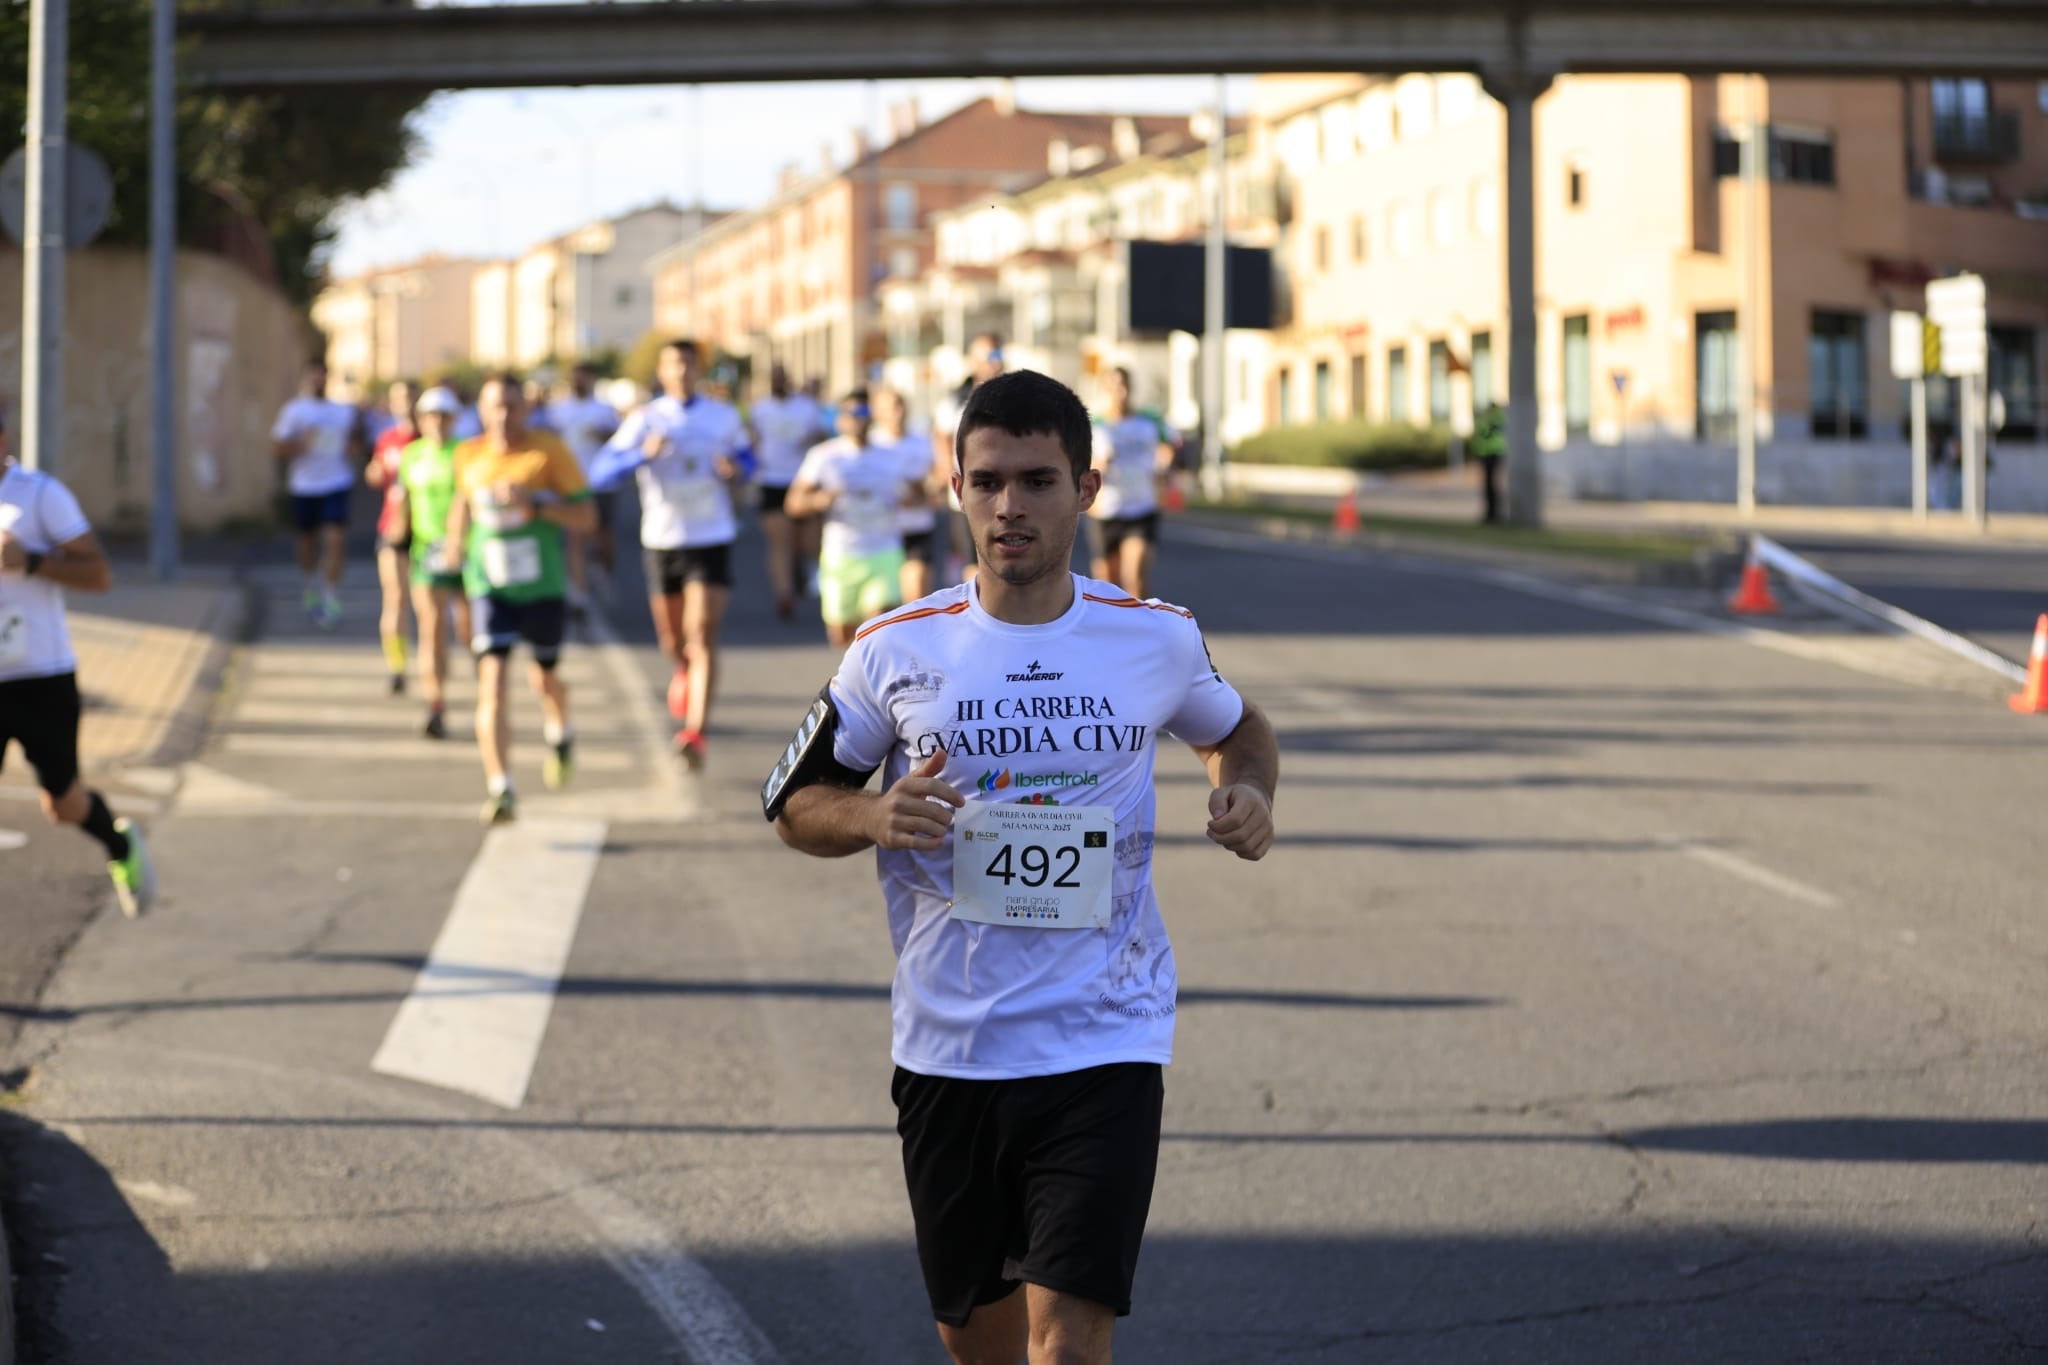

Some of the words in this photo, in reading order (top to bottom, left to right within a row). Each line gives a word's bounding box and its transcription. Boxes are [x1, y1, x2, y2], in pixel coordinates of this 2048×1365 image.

[1005, 672, 1064, 683] TEAMERGY
[956, 699, 983, 722] III
[995, 695, 1116, 719] CARRERA
[1015, 770, 1099, 788] Iberdrola
[989, 810, 1026, 819] CARRERA
[1002, 822, 1050, 831] SALAMANCA
[985, 843, 1081, 888] 492
[1029, 896, 1061, 906] grupo
[1005, 904, 1060, 913] EMPRESARIAL
